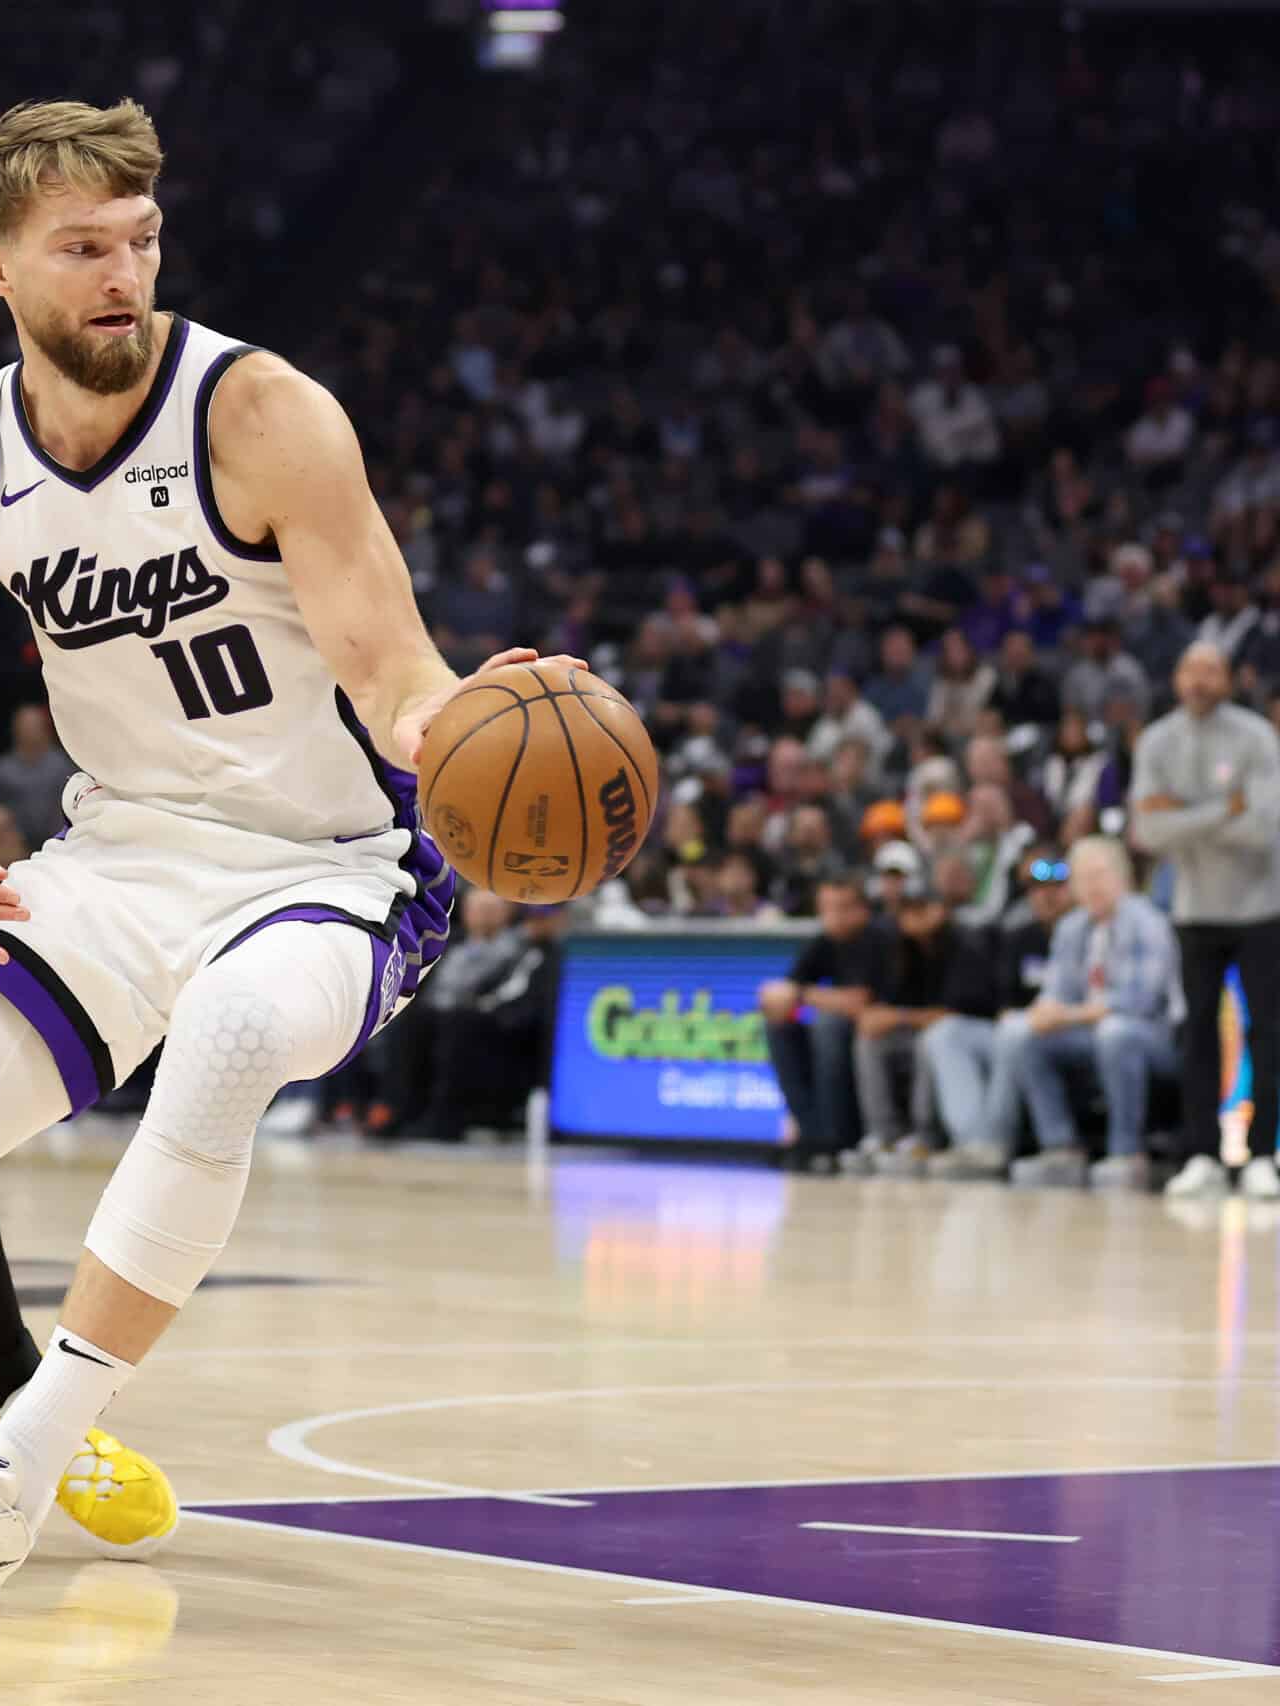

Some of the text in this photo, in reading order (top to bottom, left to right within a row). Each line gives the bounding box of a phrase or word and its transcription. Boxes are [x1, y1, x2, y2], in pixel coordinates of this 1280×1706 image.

[124, 461, 189, 484] dialpad
[10, 546, 229, 650] Kings
[150, 624, 273, 720] 10
